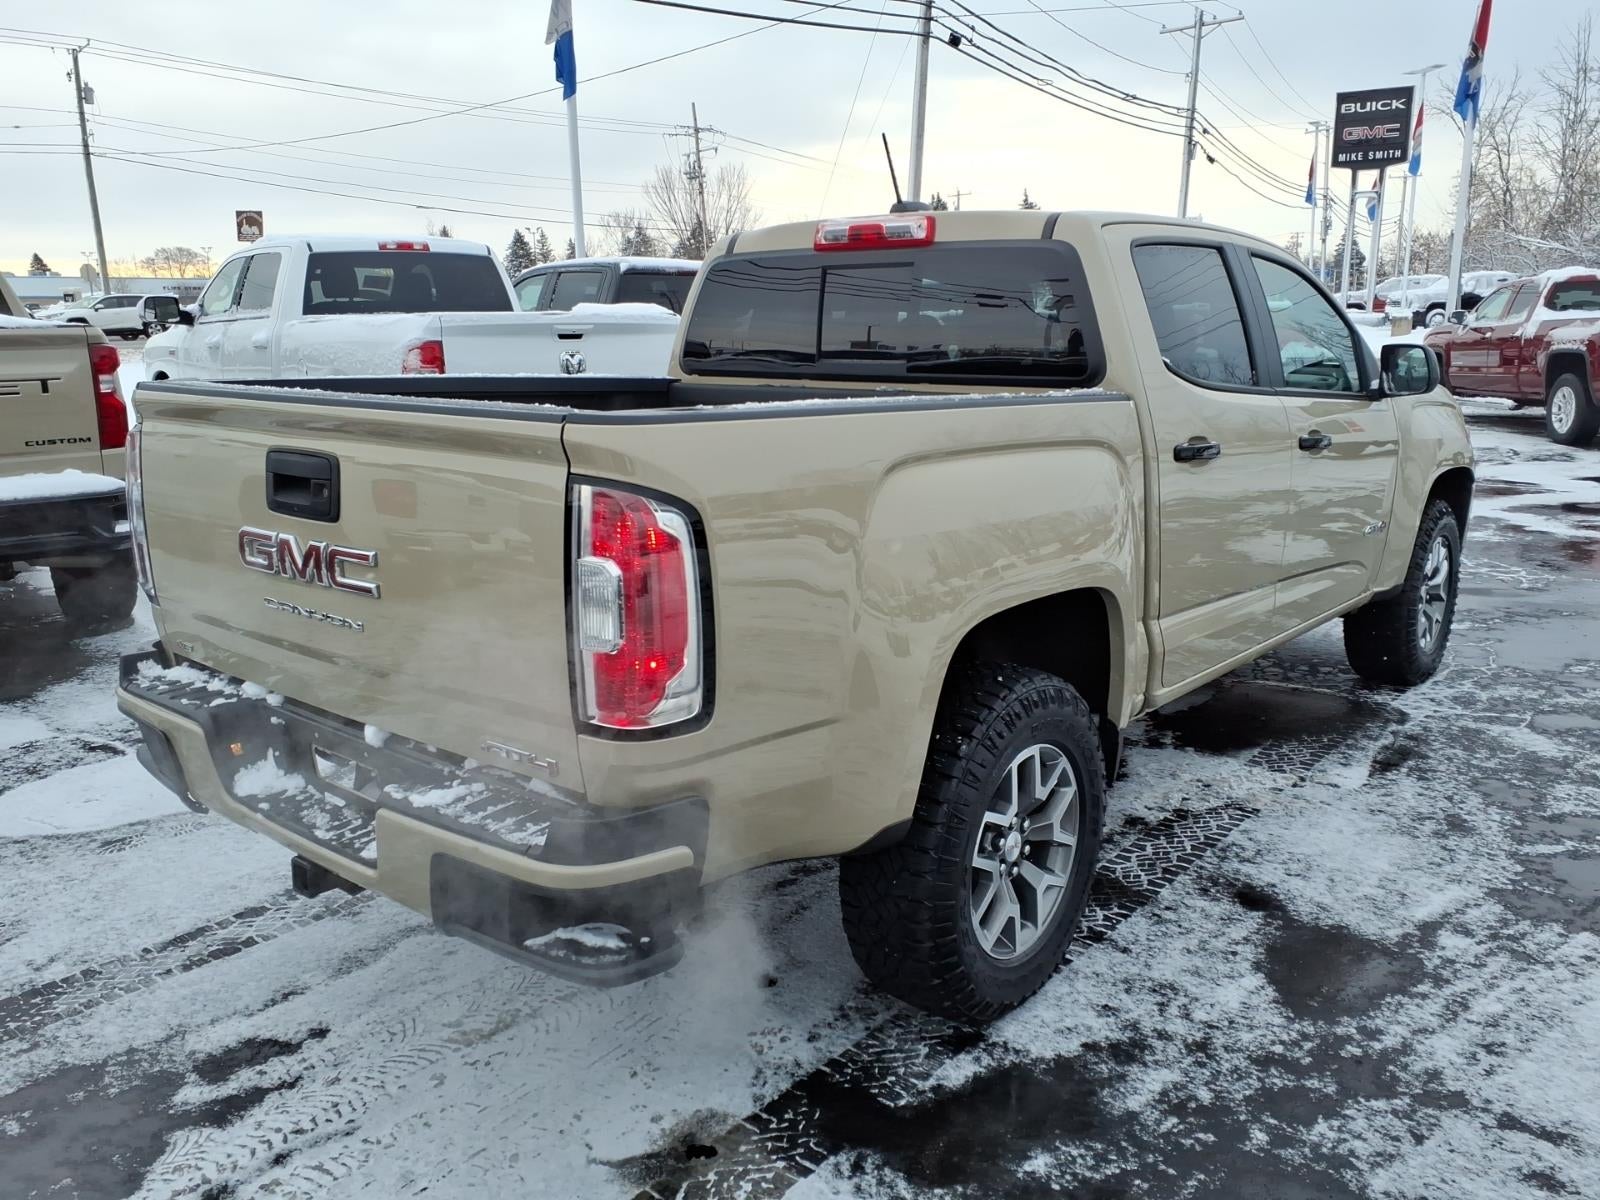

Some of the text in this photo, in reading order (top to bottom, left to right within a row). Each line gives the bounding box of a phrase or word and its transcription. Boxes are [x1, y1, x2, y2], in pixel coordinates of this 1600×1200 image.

[1341, 98, 1407, 114] BUICK
[1343, 123, 1401, 141] GMC
[1338, 149, 1402, 162] MIKE SMITH
[24, 437, 92, 447] CUSTOM
[238, 525, 381, 599] GMC
